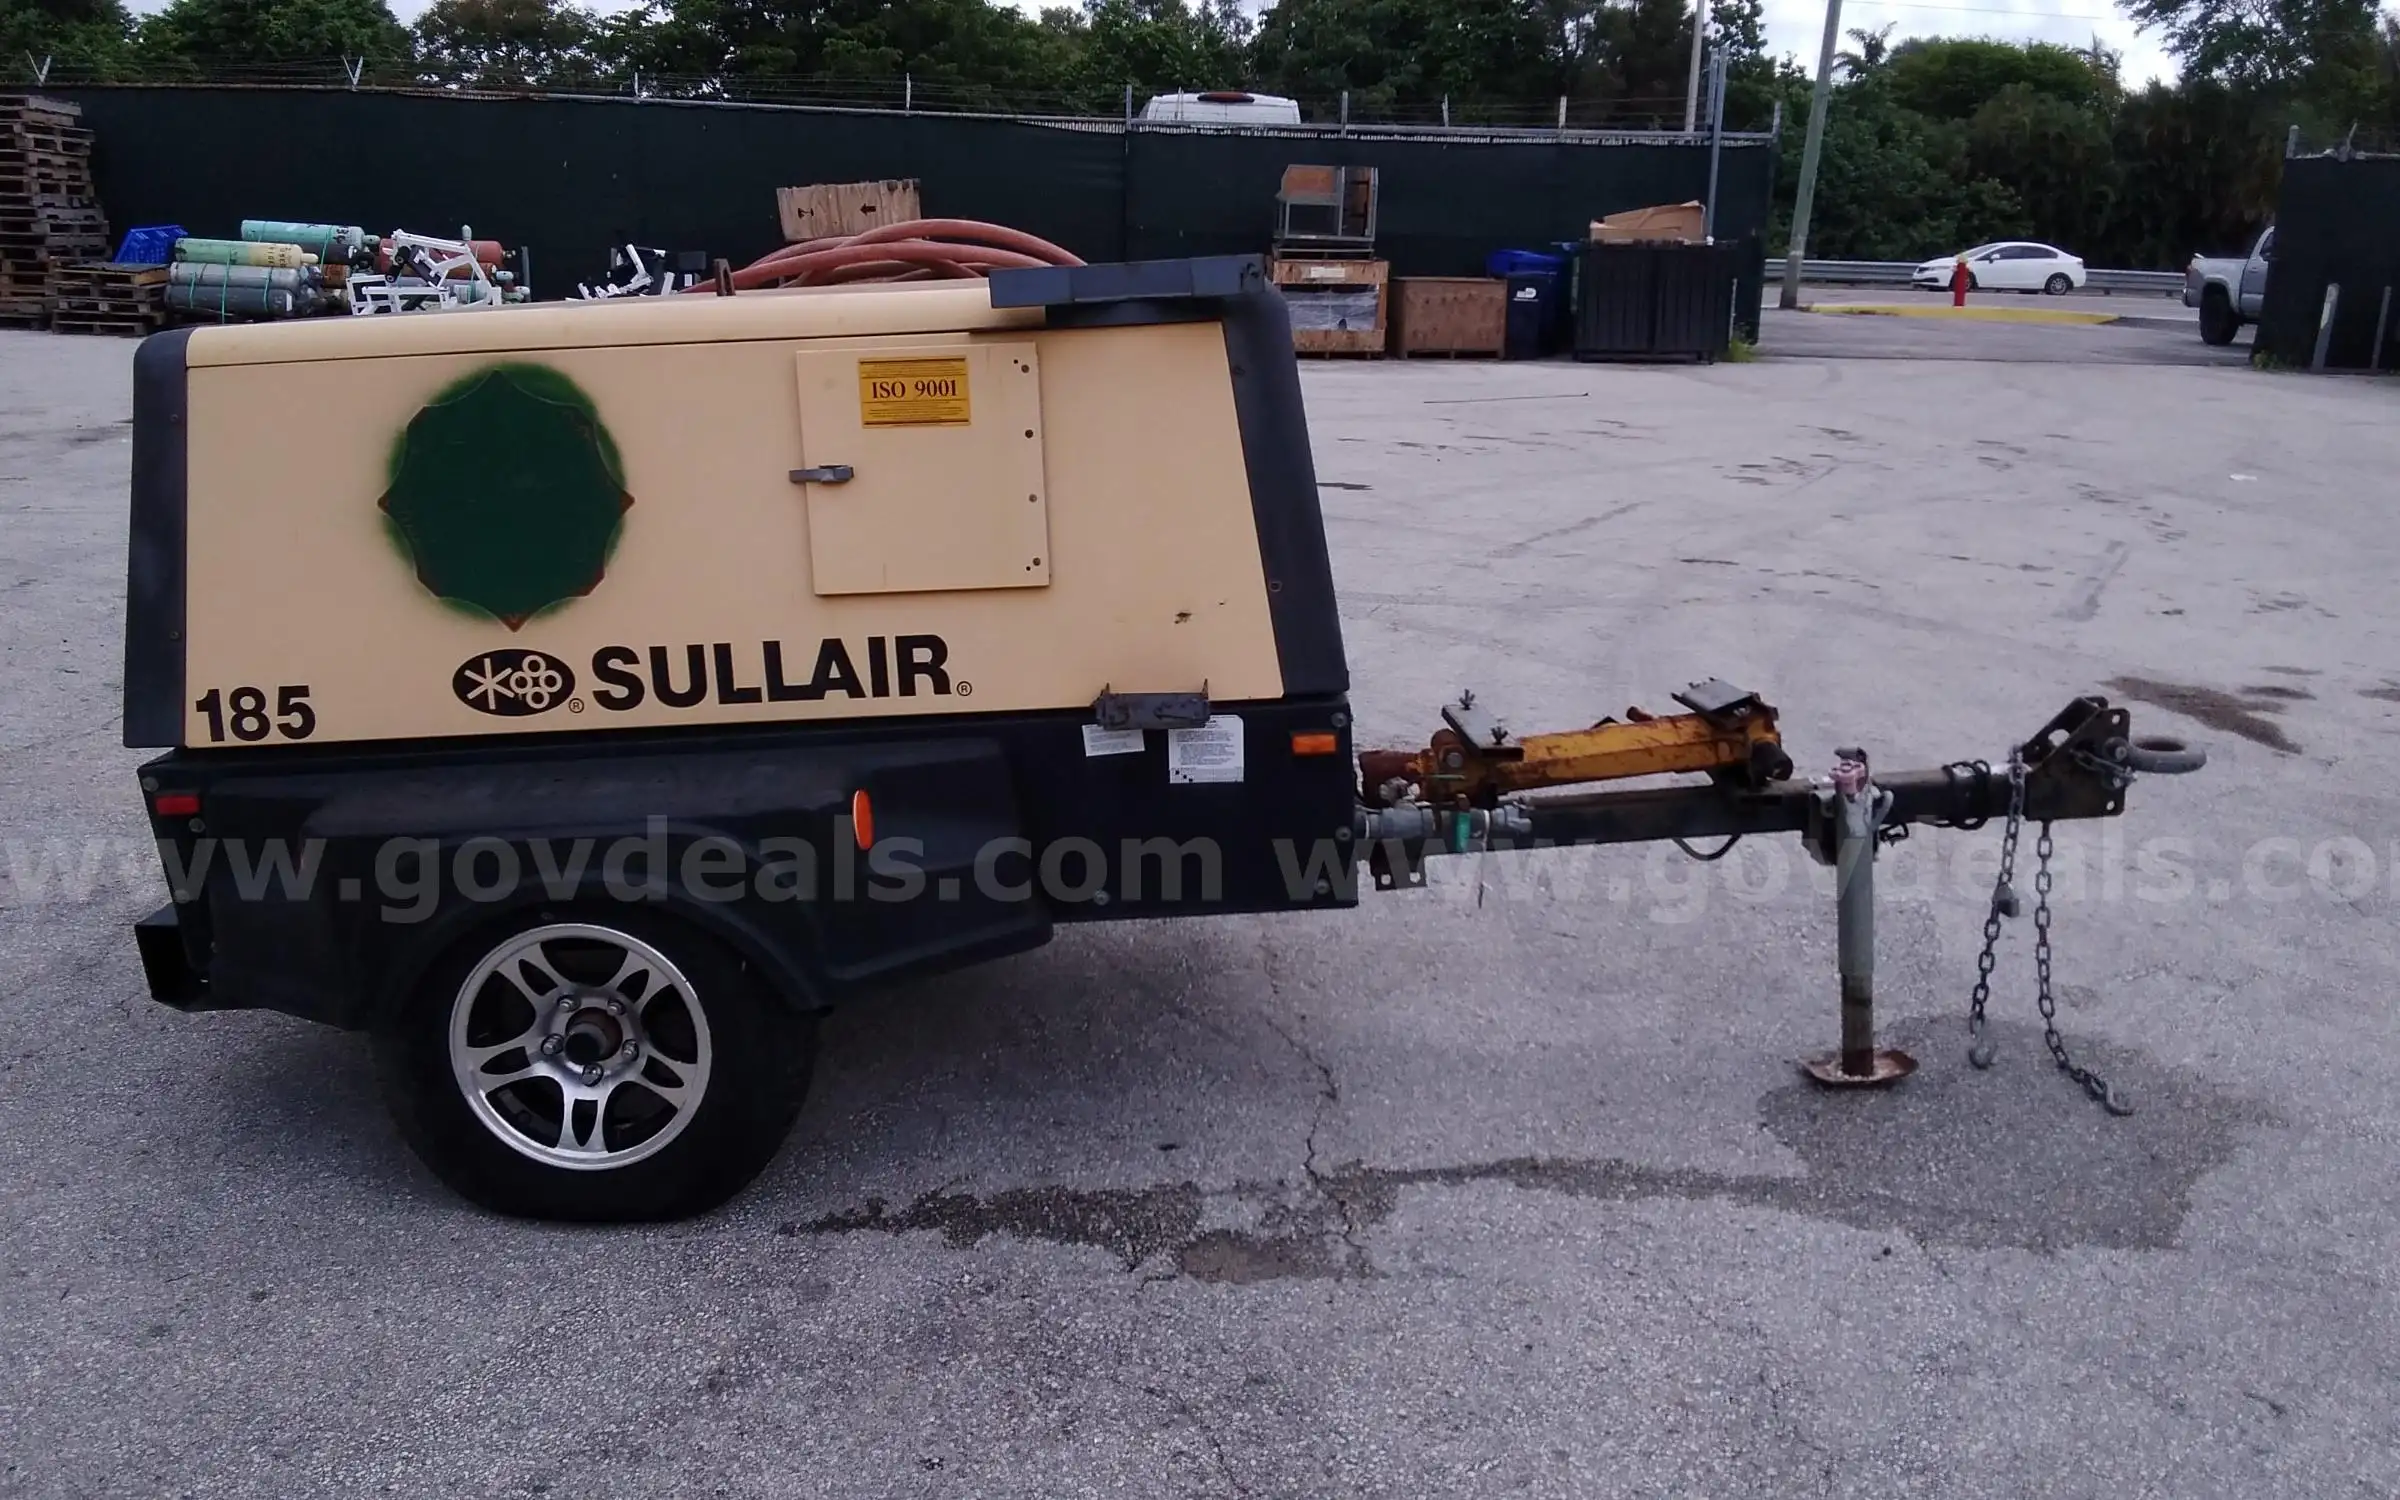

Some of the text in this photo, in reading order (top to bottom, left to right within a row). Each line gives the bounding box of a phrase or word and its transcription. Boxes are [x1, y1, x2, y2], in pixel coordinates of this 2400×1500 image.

[872, 379, 957, 399] ISO 9001
[592, 633, 952, 711] SULLAIR
[196, 685, 315, 742] 185
